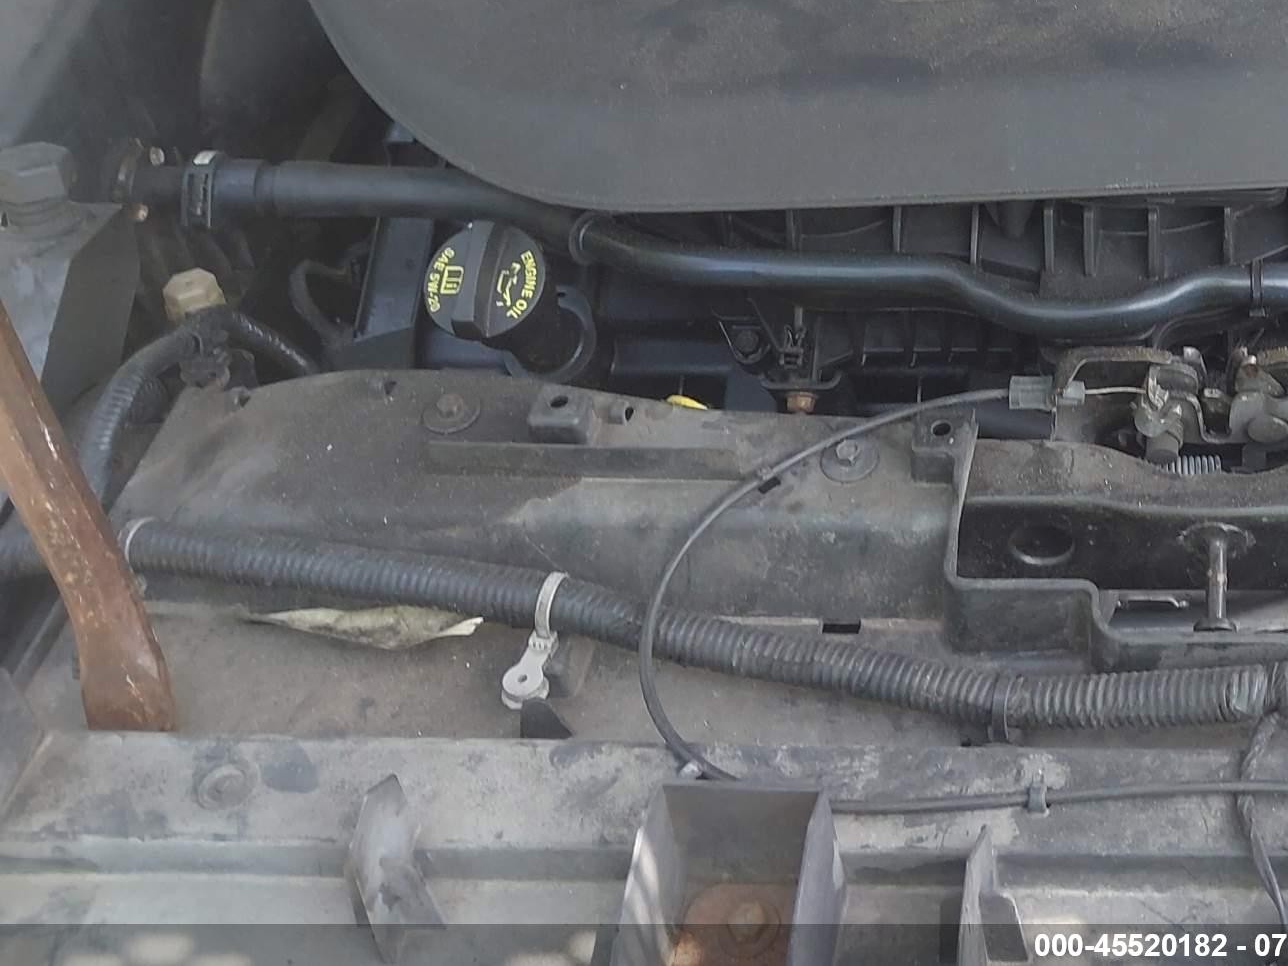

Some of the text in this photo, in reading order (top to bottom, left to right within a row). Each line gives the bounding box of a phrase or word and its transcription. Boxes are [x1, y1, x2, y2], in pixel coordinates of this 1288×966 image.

[427, 247, 455, 312] SAE 5W-20
[506, 250, 537, 319] ENGINE OIL
